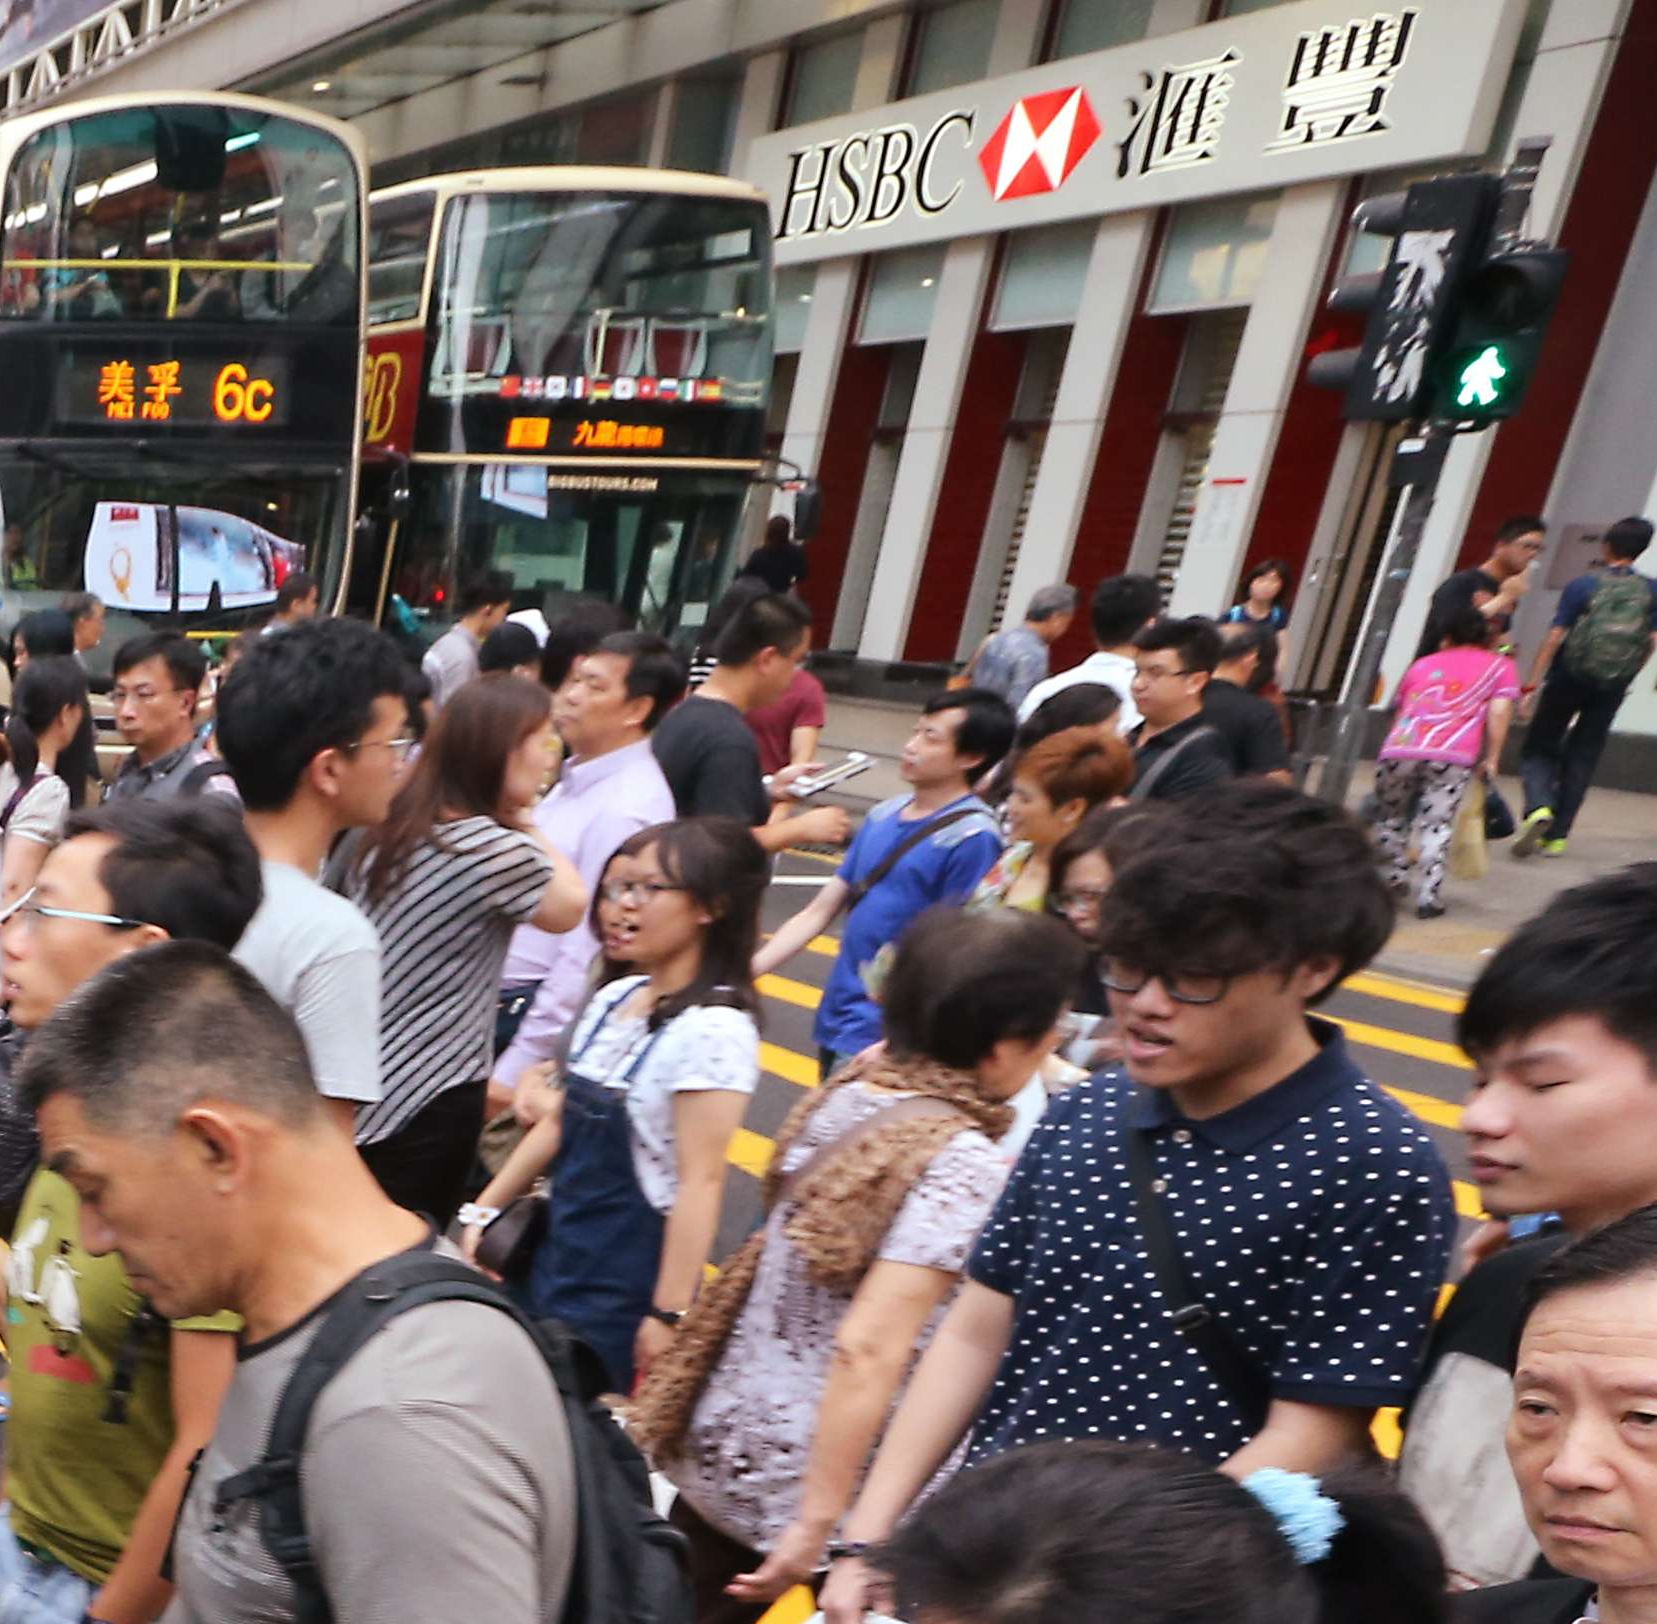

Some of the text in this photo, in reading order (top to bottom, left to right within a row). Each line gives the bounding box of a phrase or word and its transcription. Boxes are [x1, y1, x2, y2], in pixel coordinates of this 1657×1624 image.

[776, 111, 975, 238] HSBC
[98, 360, 183, 402] 美孚
[107, 402, 171, 419] MEI FOO
